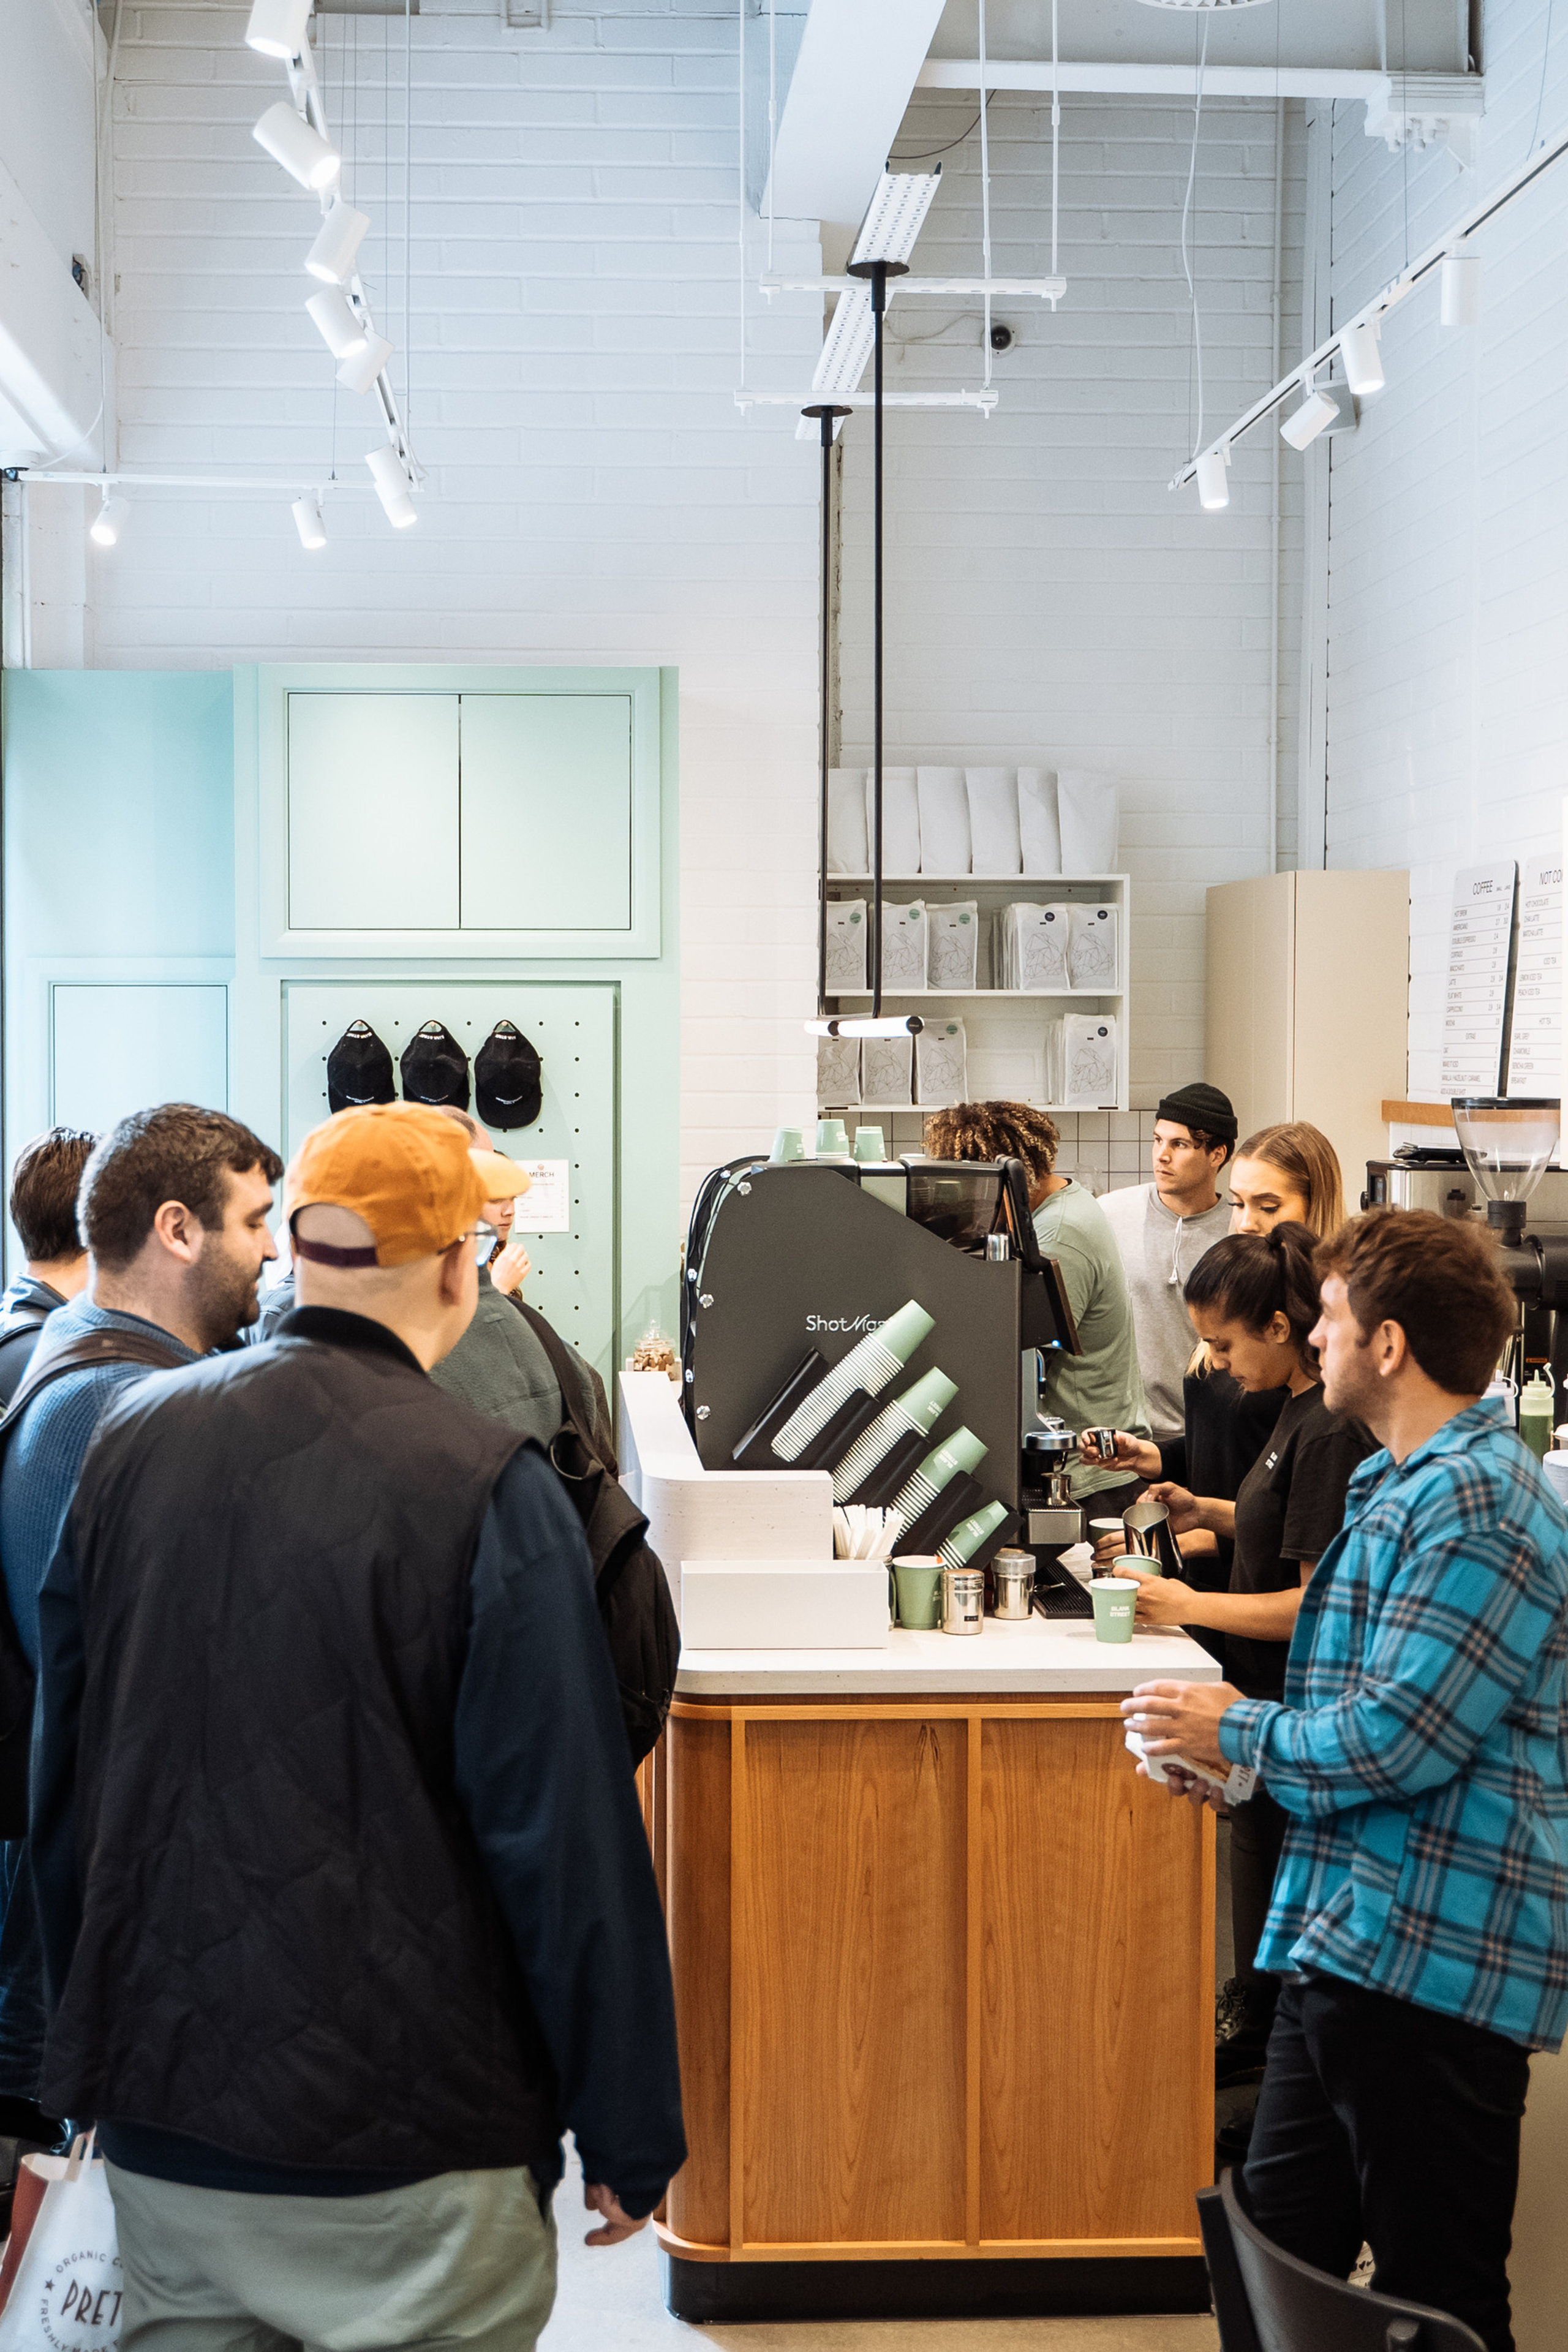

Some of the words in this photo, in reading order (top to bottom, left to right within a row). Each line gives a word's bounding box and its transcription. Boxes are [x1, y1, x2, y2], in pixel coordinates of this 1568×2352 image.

[1472, 880, 1493, 895] COFFEE
[1539, 871, 1552, 886] NOT
[1552, 869, 1563, 883] CO
[56, 2250, 107, 2273] ORGANIC
[61, 2278, 123, 2326] PRET
[40, 2299, 69, 2351] FRESHLY
